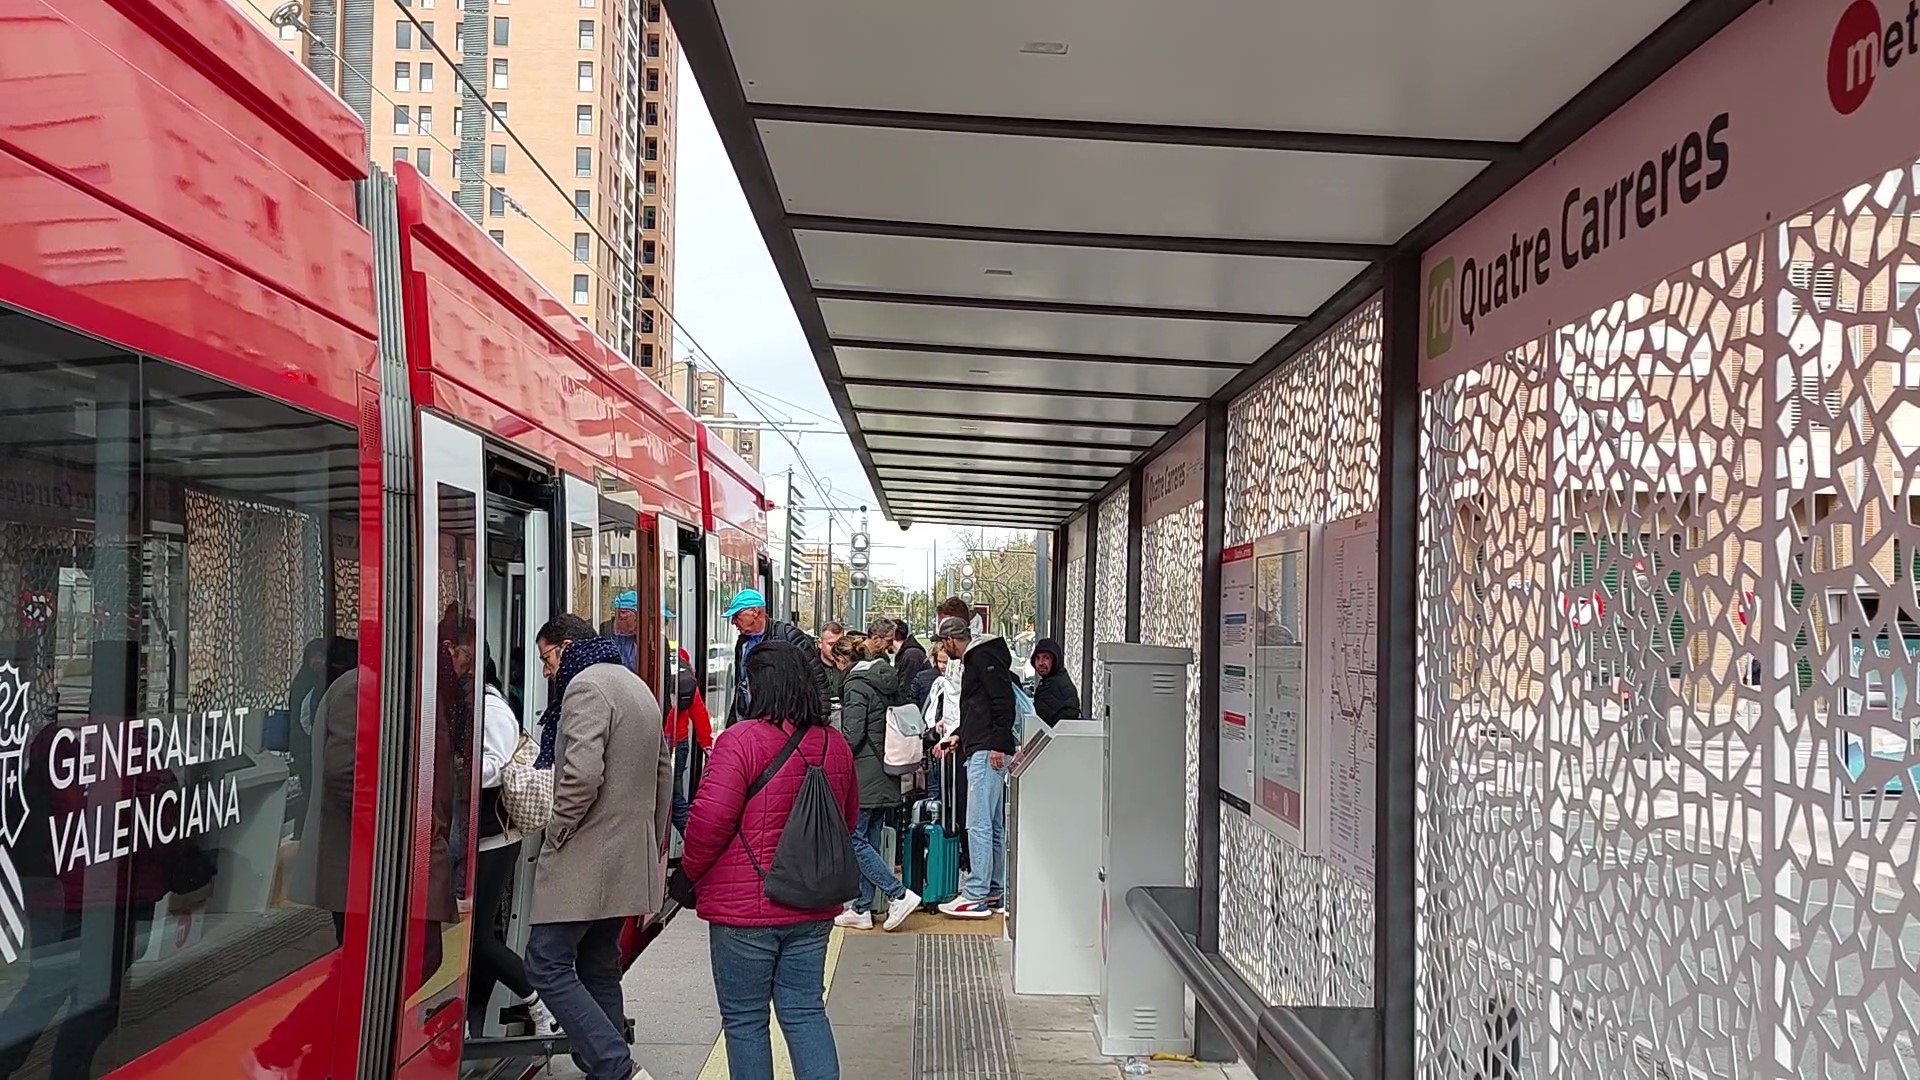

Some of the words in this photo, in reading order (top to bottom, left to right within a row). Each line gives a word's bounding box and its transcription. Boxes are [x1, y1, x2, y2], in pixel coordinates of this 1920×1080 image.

[1429, 277, 1453, 340] 10
[1460, 227, 1551, 337] Quatre
[1561, 112, 1730, 270] Carreres
[49, 706, 249, 789] GENERALITAT
[49, 775, 241, 876] VALENCIANA
